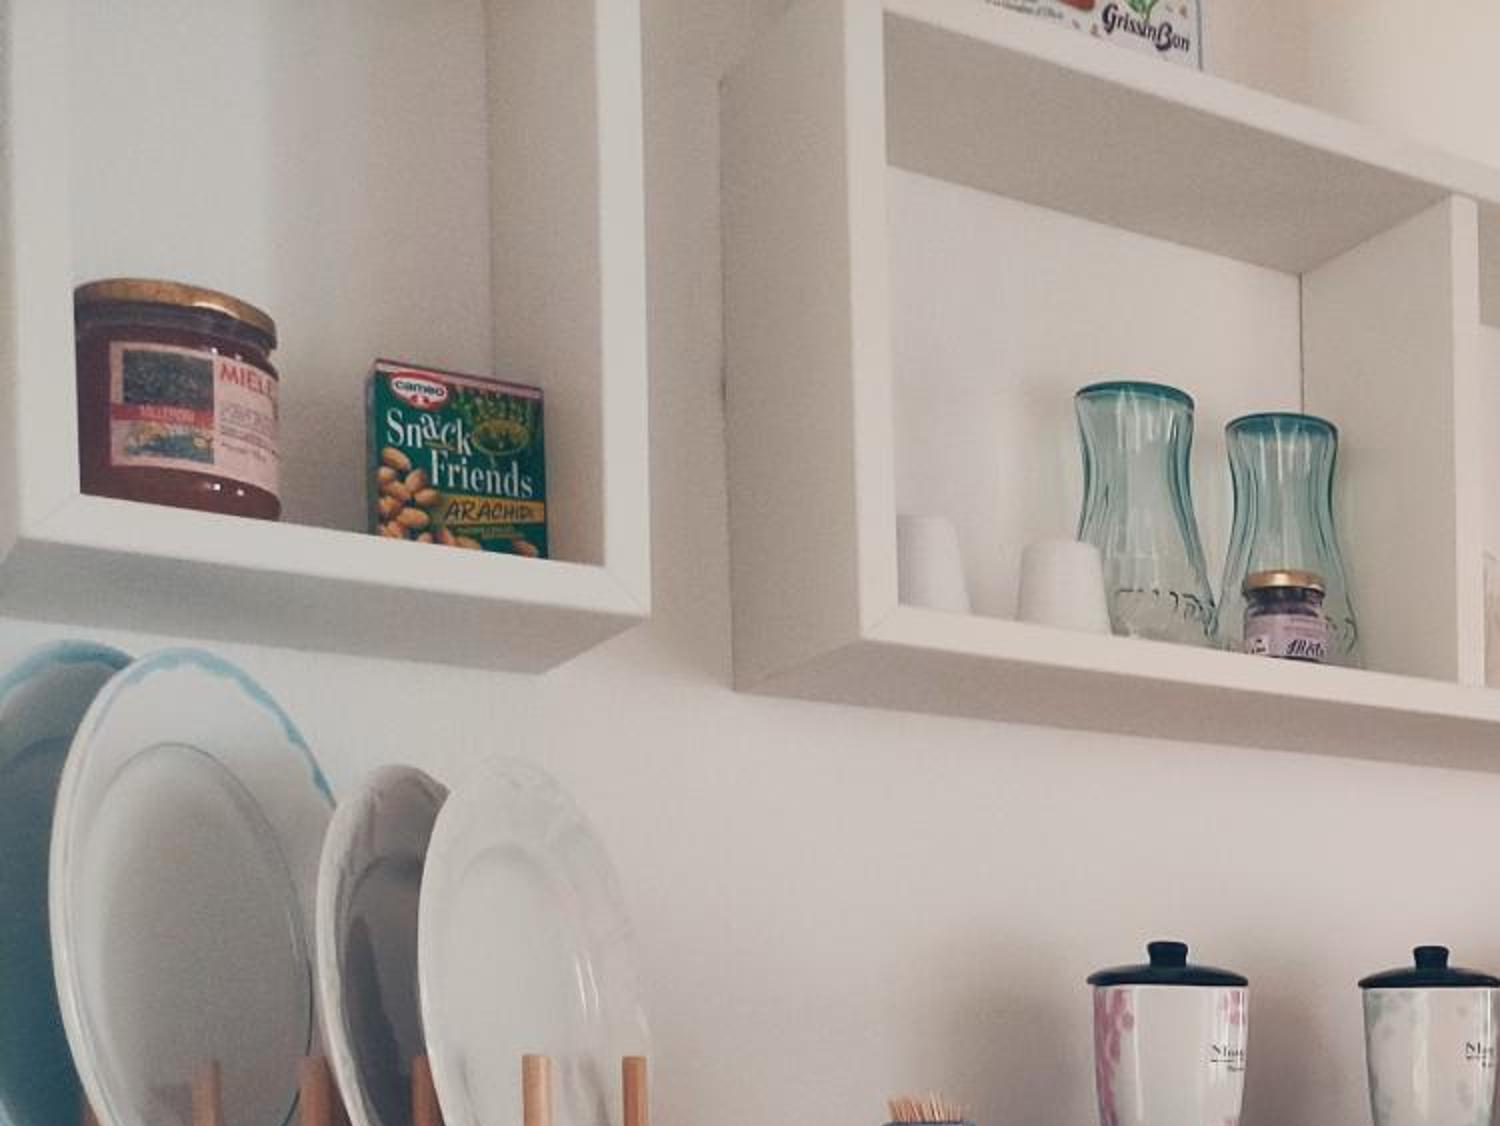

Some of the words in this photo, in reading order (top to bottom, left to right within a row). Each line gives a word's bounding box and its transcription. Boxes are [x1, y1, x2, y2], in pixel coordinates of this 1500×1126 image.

[1102, 3, 1190, 53] GrissinBon
[394, 381, 445, 397] cameo
[387, 408, 472, 456] Snack
[431, 450, 533, 499] Friends
